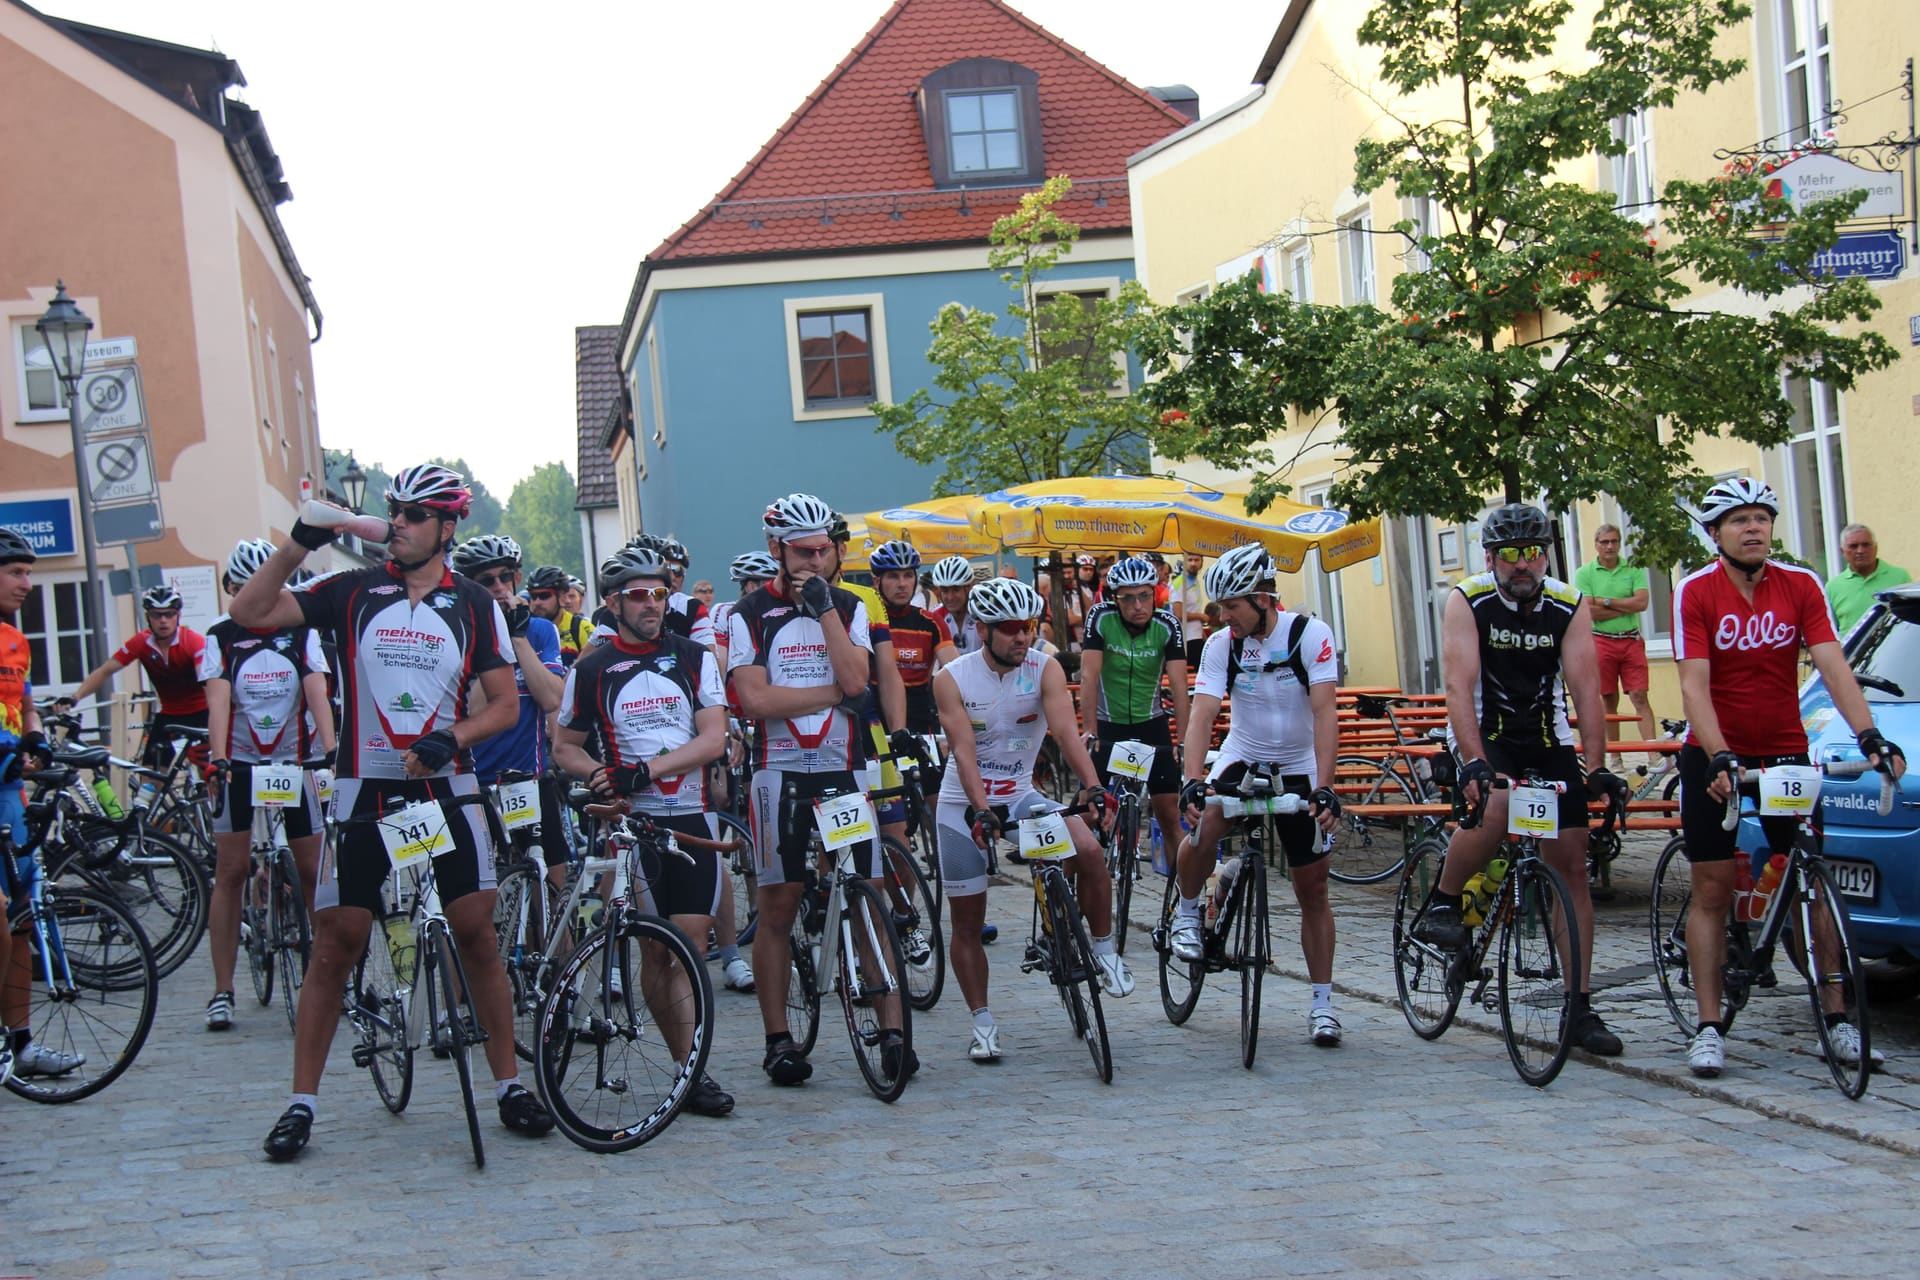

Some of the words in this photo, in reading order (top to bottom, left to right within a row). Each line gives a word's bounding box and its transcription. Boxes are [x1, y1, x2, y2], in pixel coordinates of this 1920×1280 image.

[1798, 174, 1834, 186] Mehr
[80, 344, 122, 358] useum
[94, 384, 119, 404] 30
[95, 415, 127, 428] ZONE
[105, 484, 137, 497] ZONE
[376, 626, 446, 644] meixner
[778, 643, 828, 655] meixne
[1106, 643, 1159, 658] NALINI
[377, 651, 420, 663] Neunburg
[383, 659, 436, 672] Schwandorf
[781, 665, 815, 674] Neunburg
[243, 670, 292, 681] meixner
[621, 695, 681, 710] meixner
[628, 716, 666, 728] Neunburg
[1128, 752, 1136, 763] 6
[264, 778, 291, 791] 140
[1781, 781, 1802, 797] 18
[505, 795, 527, 813] 135
[1528, 803, 1546, 819] 19
[832, 807, 859, 829] 137
[398, 821, 430, 844] 141
[1036, 830, 1055, 847] 16
